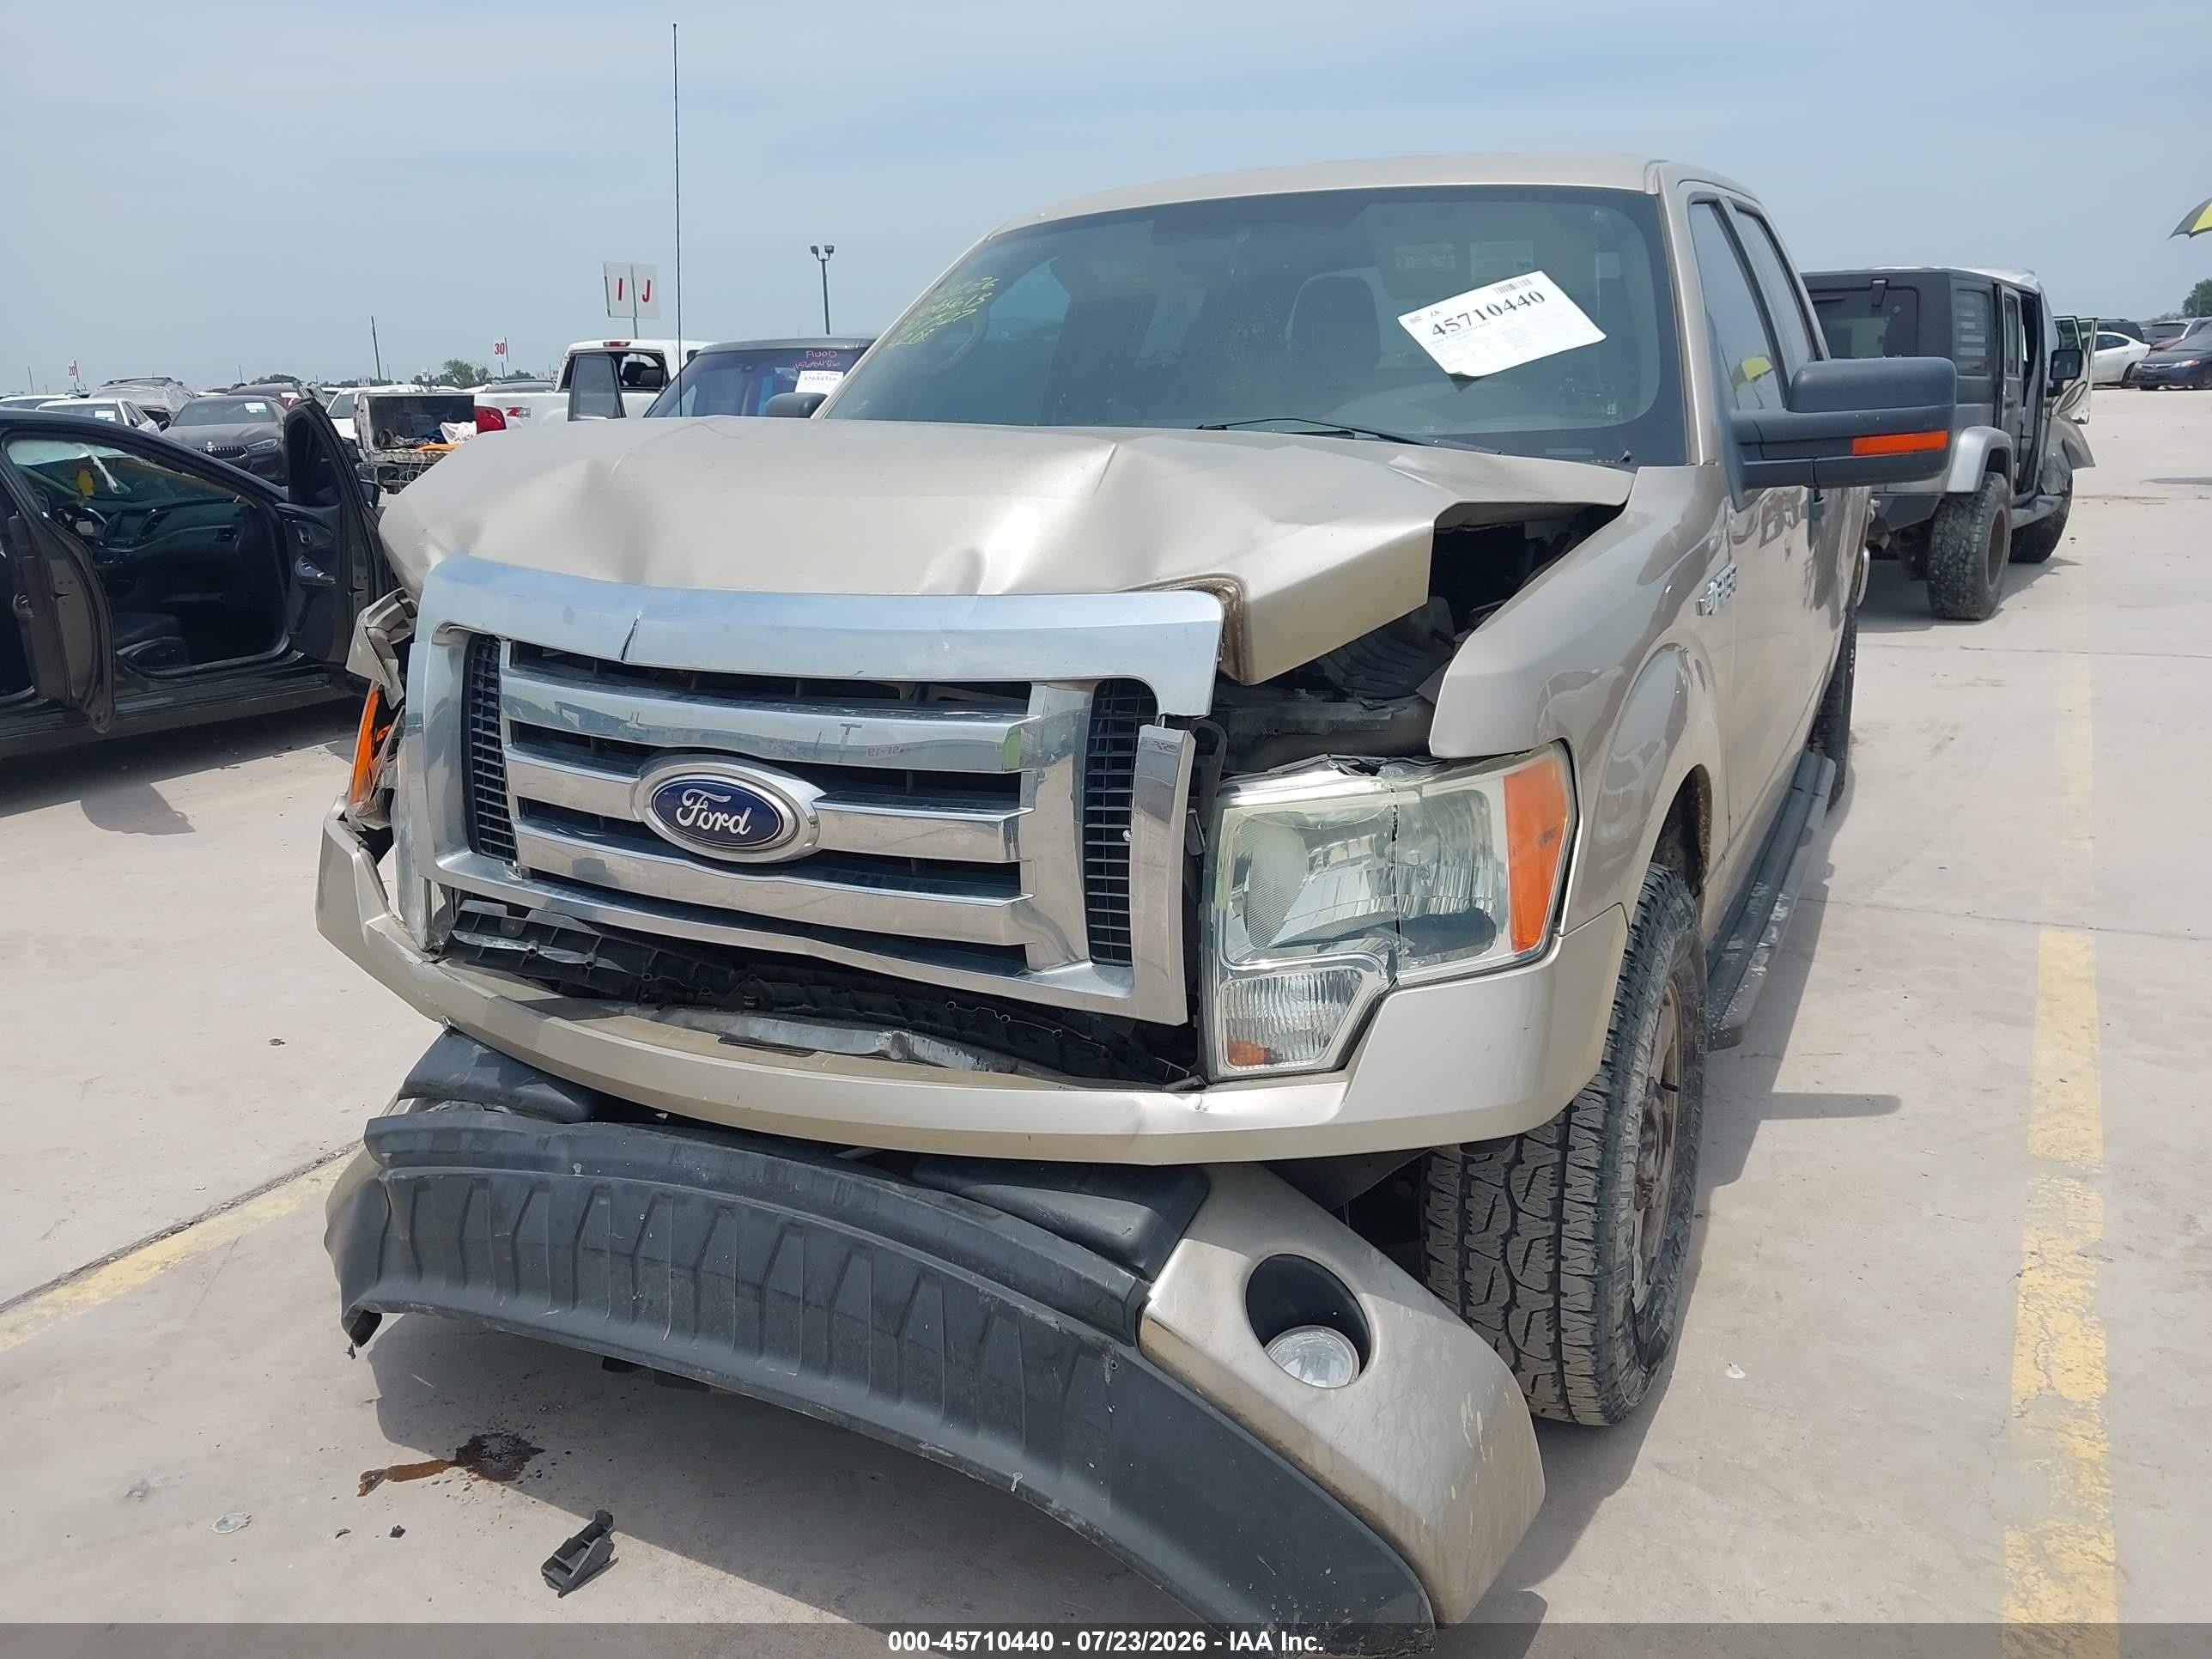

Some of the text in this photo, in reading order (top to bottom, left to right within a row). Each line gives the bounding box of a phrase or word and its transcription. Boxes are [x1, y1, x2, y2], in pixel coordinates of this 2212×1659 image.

[642, 279, 650, 302] J
[1432, 290, 1545, 335] 45710440
[495, 343, 505, 355] 30
[69, 366, 76, 376] 20
[677, 788, 752, 836] Ford
